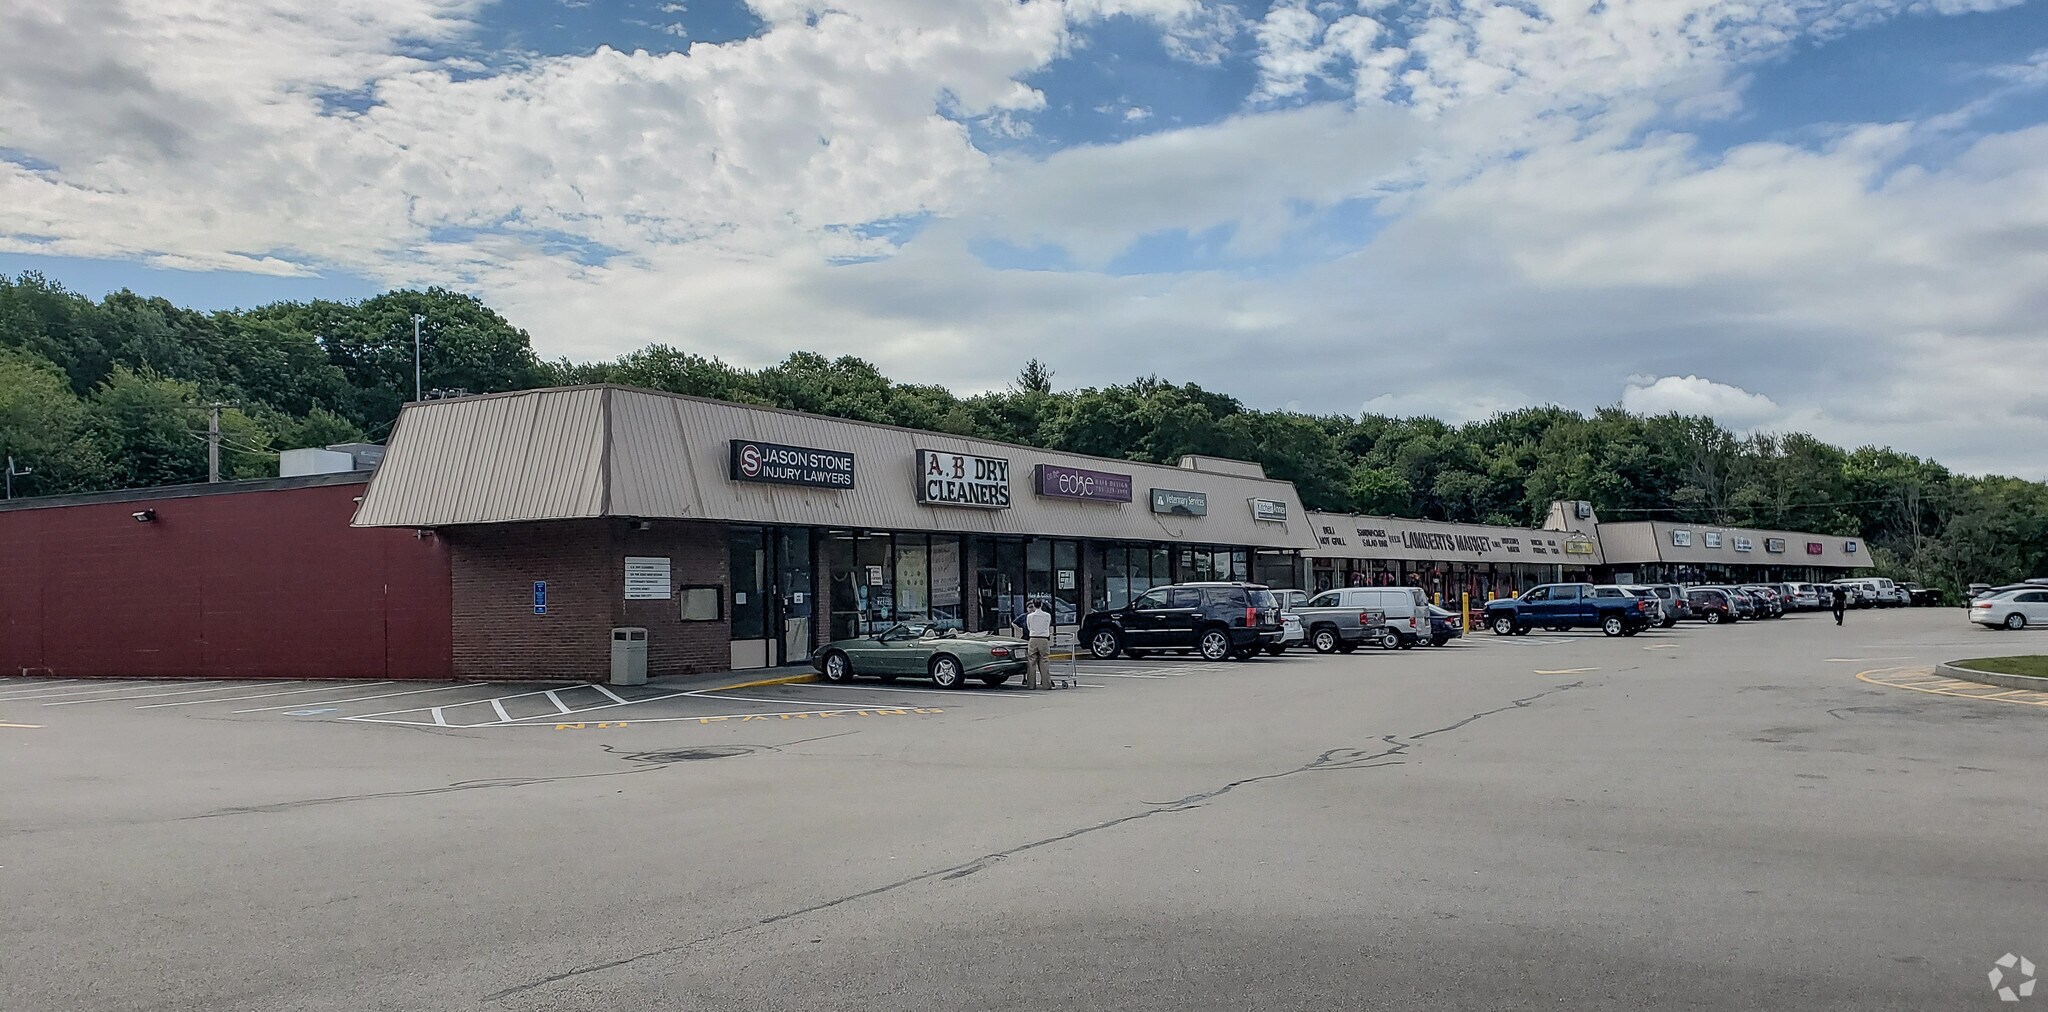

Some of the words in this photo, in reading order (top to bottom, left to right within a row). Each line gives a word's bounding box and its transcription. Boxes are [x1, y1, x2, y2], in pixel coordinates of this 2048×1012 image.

[762, 448, 808, 467] JASON
[809, 453, 852, 471] STONE
[974, 458, 1008, 481] DRY
[762, 465, 801, 480] INJURY
[803, 470, 851, 485] LAWYERS
[1059, 470, 1094, 496] edge
[1322, 526, 1335, 535] DELI
[1331, 537, 1347, 546] GRILL
[1401, 530, 1455, 551] LAMBERTS
[1454, 534, 1492, 552] MARKET
[555, 722, 628, 731] NO
[700, 708, 945, 724] PARKING
